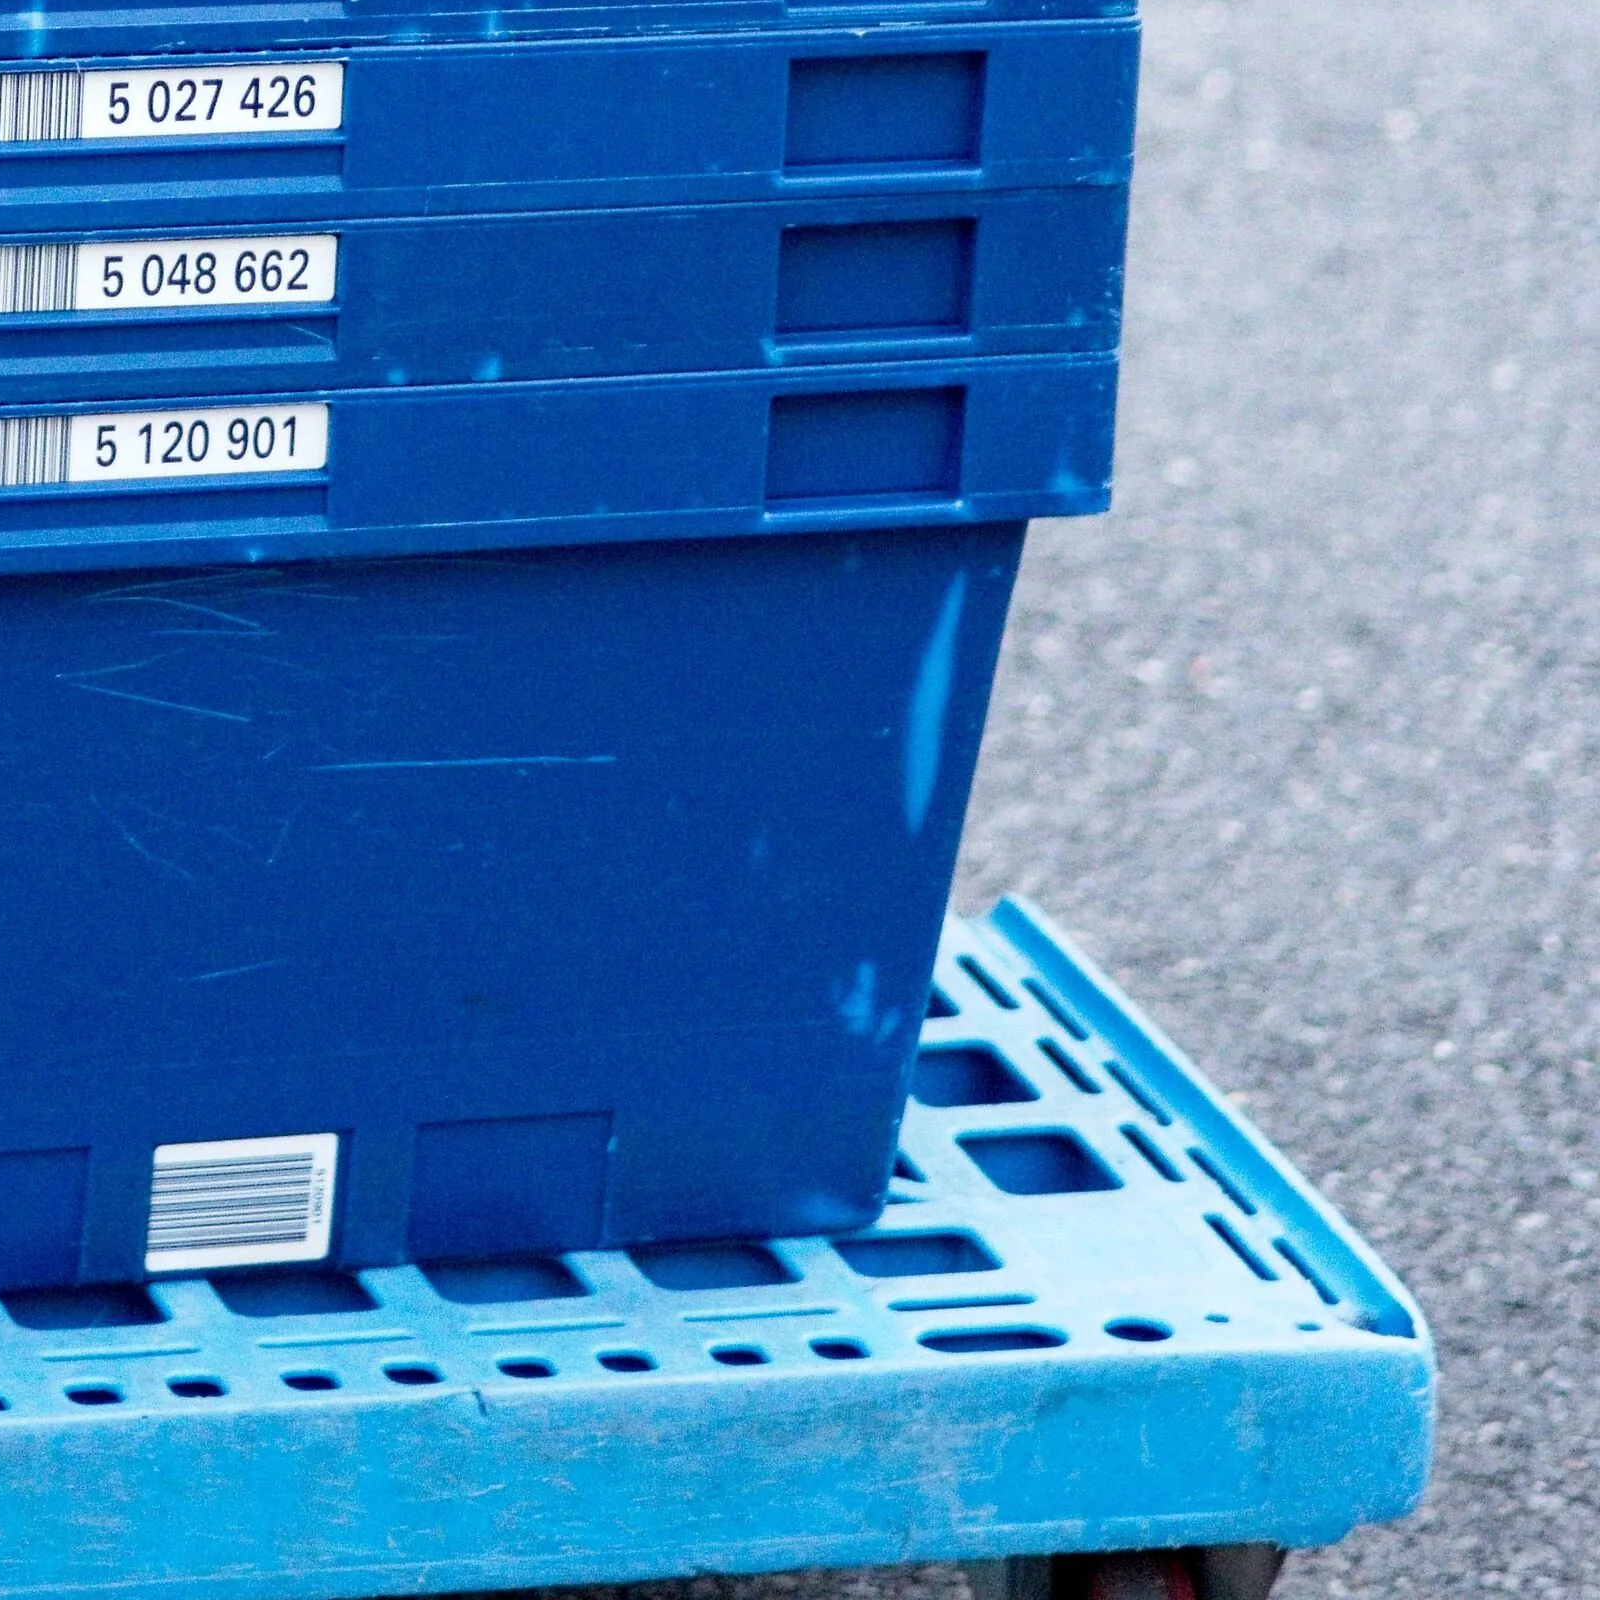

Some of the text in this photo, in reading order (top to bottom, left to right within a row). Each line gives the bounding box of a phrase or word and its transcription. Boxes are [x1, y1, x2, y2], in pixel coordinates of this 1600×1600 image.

[108, 74, 316, 125] 5 027 426
[103, 248, 310, 298] 5 048 662
[96, 415, 297, 468] 5 120 901
